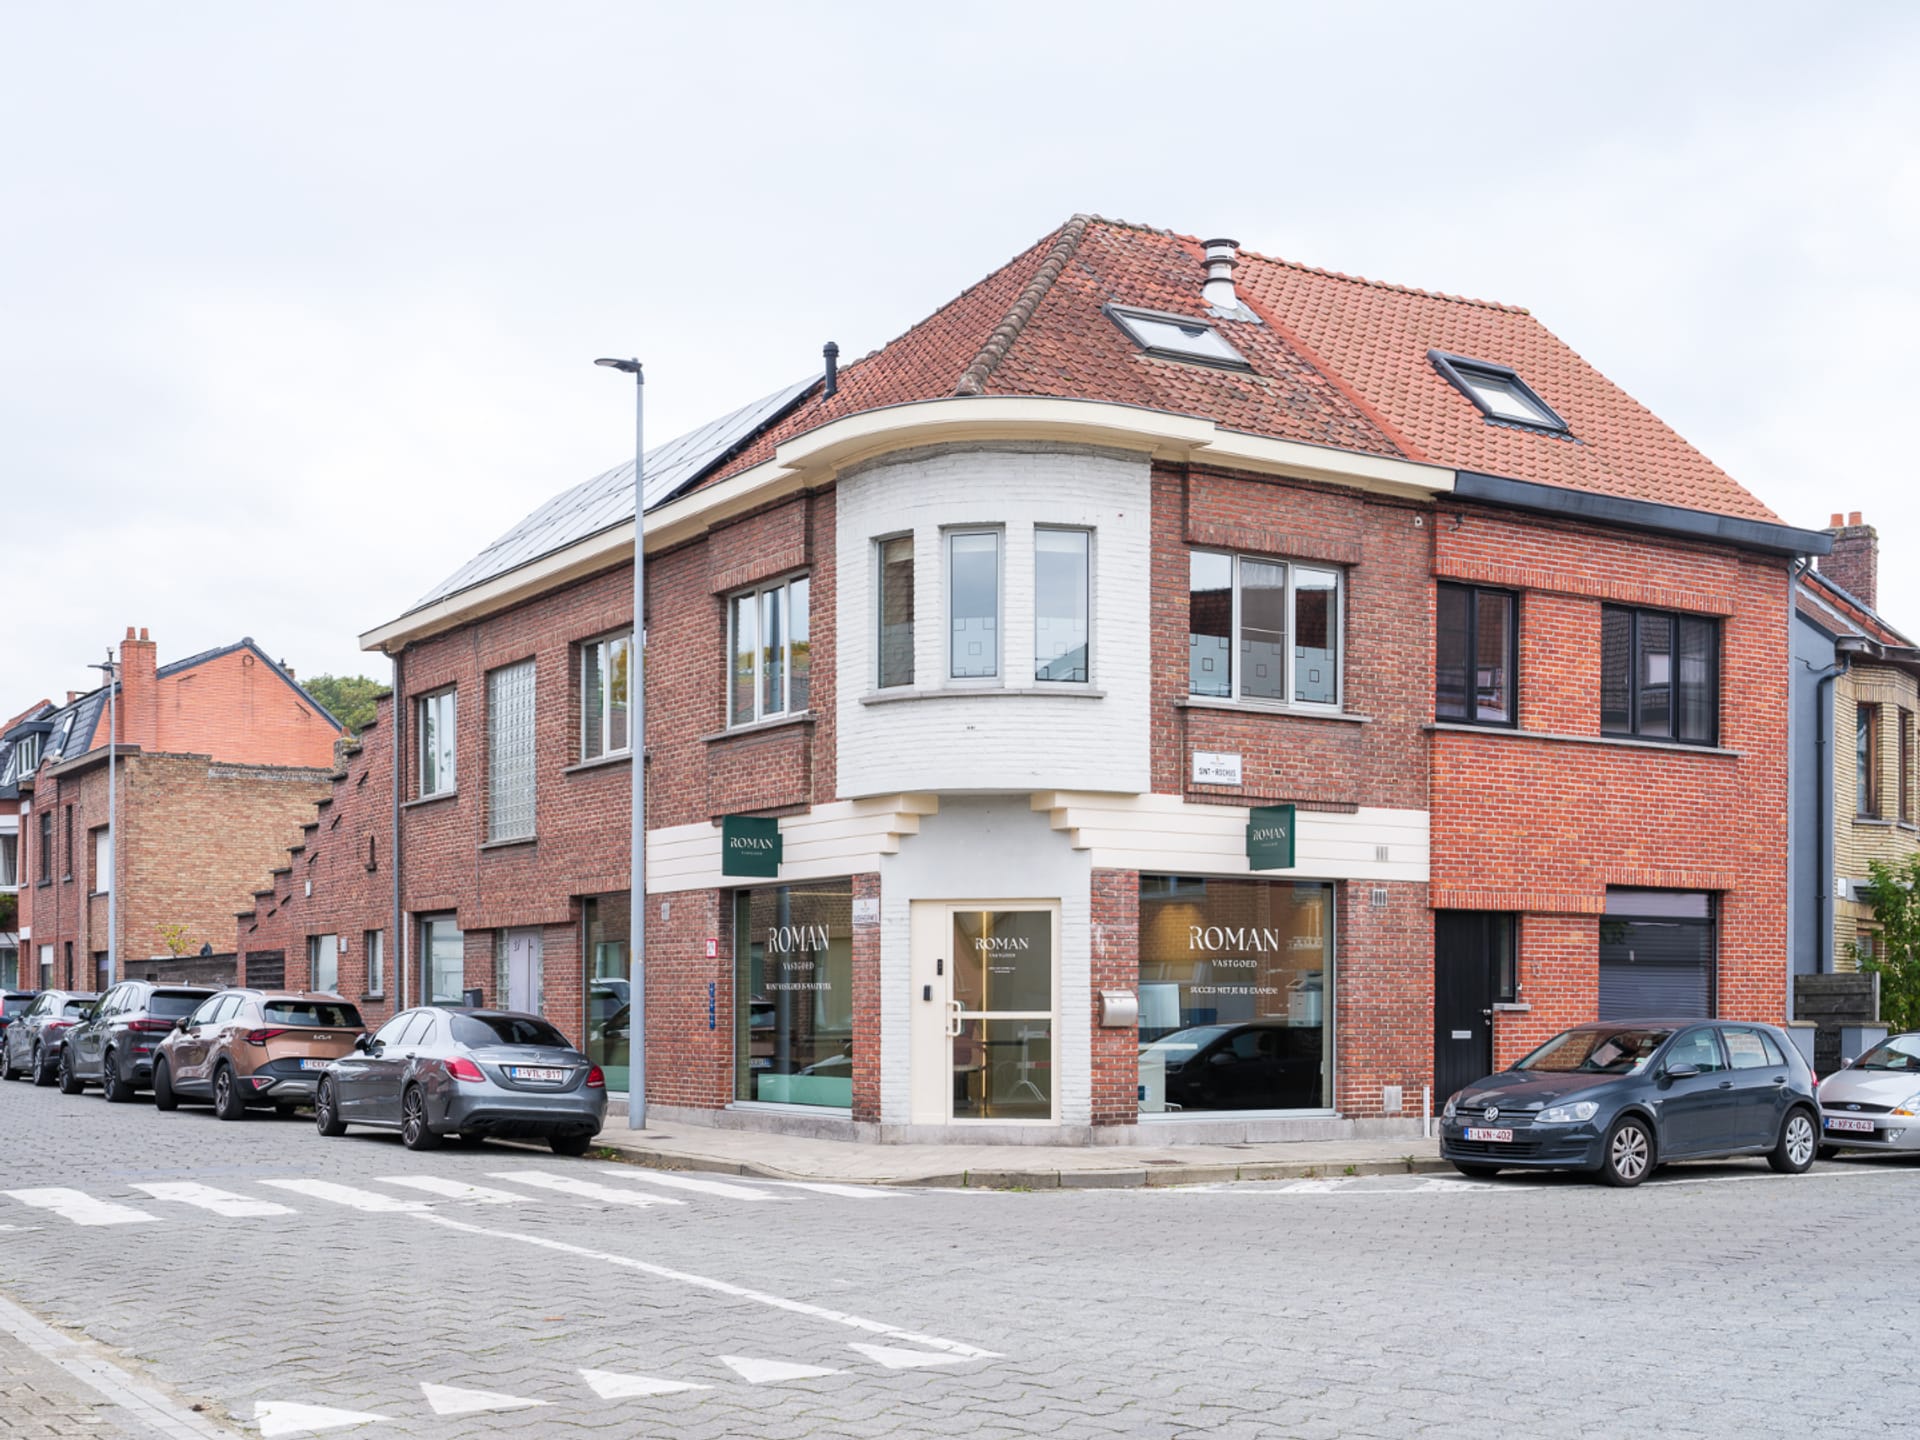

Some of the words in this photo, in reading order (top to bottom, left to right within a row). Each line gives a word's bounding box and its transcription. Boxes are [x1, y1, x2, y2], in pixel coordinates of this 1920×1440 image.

[1253, 826, 1286, 841] ROMAN
[730, 836, 774, 849] ROMAN
[768, 924, 830, 953] ROMAN
[975, 937, 1029, 950] ROMAN
[1189, 925, 1279, 952] ROMAN
[1211, 959, 1258, 968] VASTGOED
